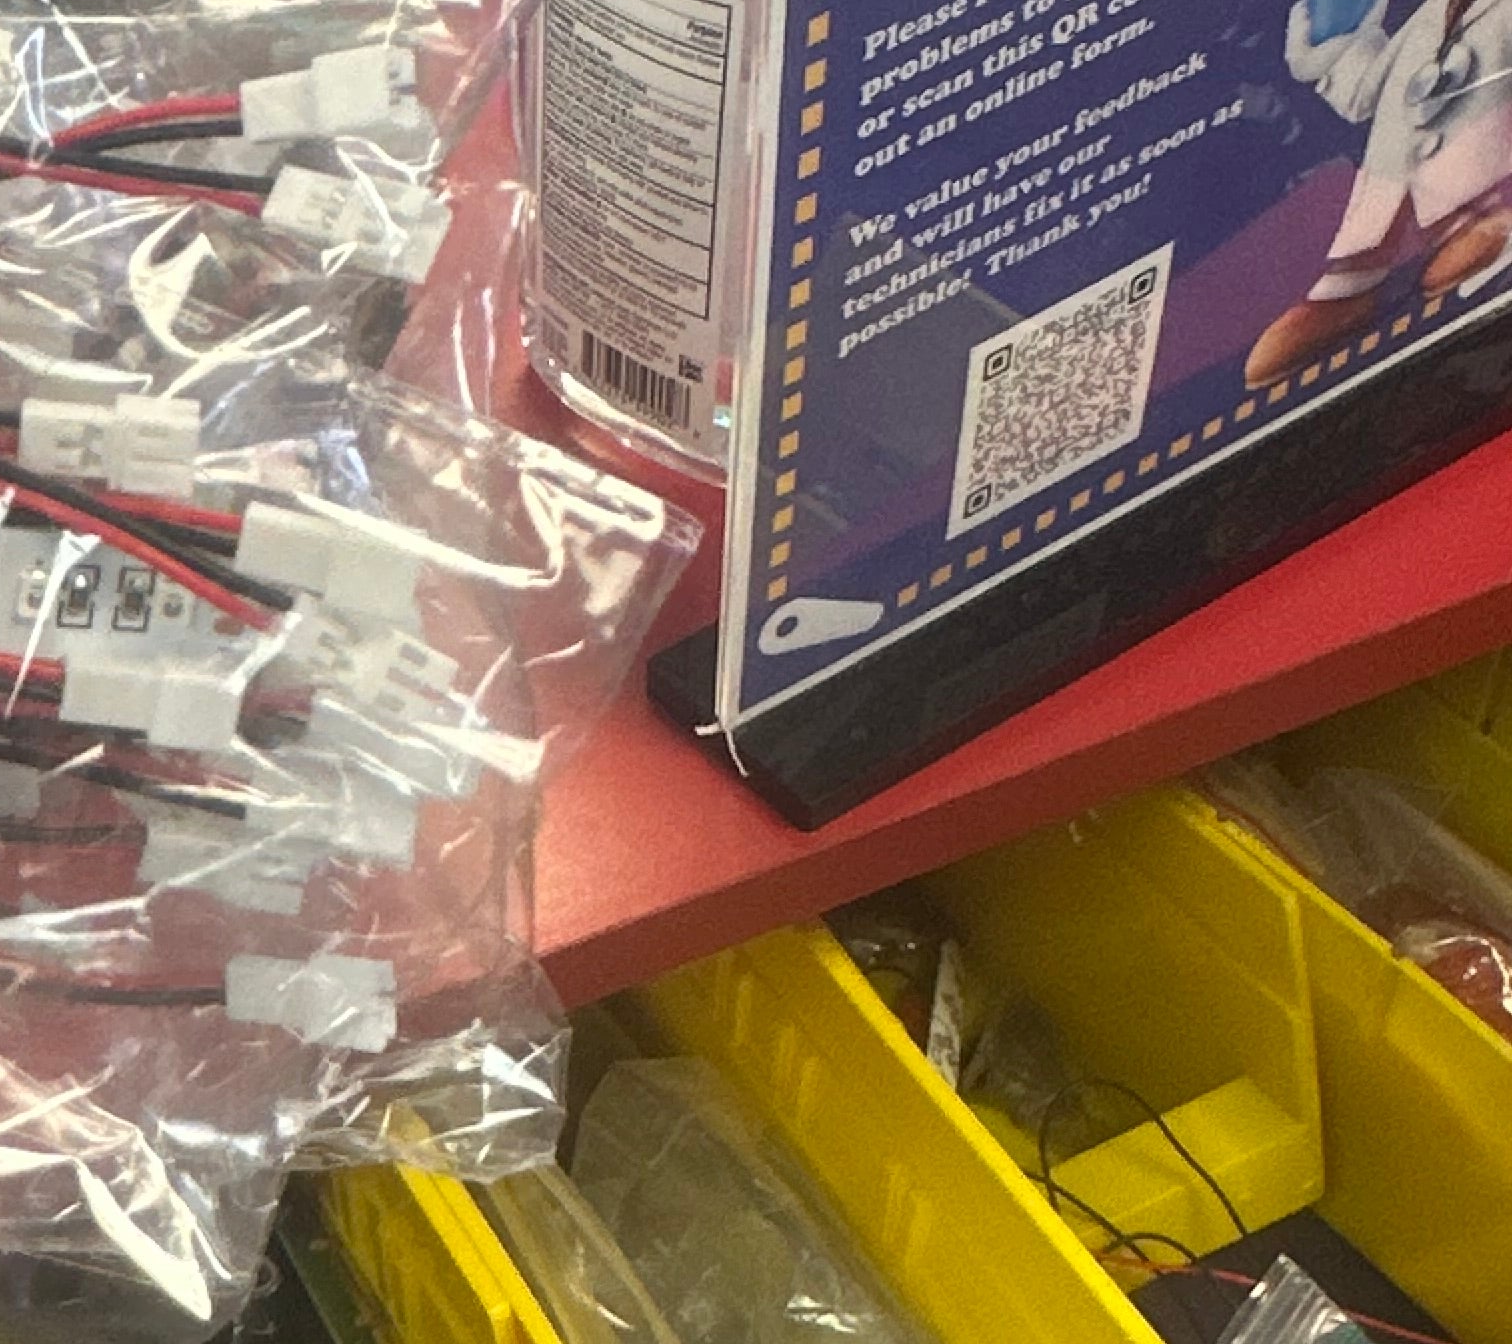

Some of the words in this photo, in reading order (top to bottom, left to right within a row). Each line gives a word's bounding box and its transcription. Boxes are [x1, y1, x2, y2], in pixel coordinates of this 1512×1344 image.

[854, 133, 911, 177] out
[917, 113, 957, 146] an
[965, 60, 1064, 122] online
[1071, 17, 1155, 69] form.
[857, 107, 895, 138] or
[902, 68, 975, 117] scan
[982, 33, 1043, 77] this
[1051, 2, 1099, 44] QR
[860, 10, 1015, 105] problems
[841, 217, 1017, 319] technicians
[1023, 191, 1065, 226] fix
[1069, 173, 1095, 201] it
[1099, 155, 1133, 183] as
[1139, 119, 1207, 165] soon
[1211, 99, 1244, 126] as
[844, 237, 904, 286] and
[911, 201, 975, 248] will
[981, 168, 1052, 217] have
[1057, 134, 1112, 176] our
[848, 214, 897, 247] We
[905, 167, 988, 219] value
[994, 125, 1069, 180] your
[1073, 52, 1207, 135] feedback
[838, 268, 973, 358] possible!
[985, 214, 1081, 276] Thank
[1086, 172, 1152, 228] you!
